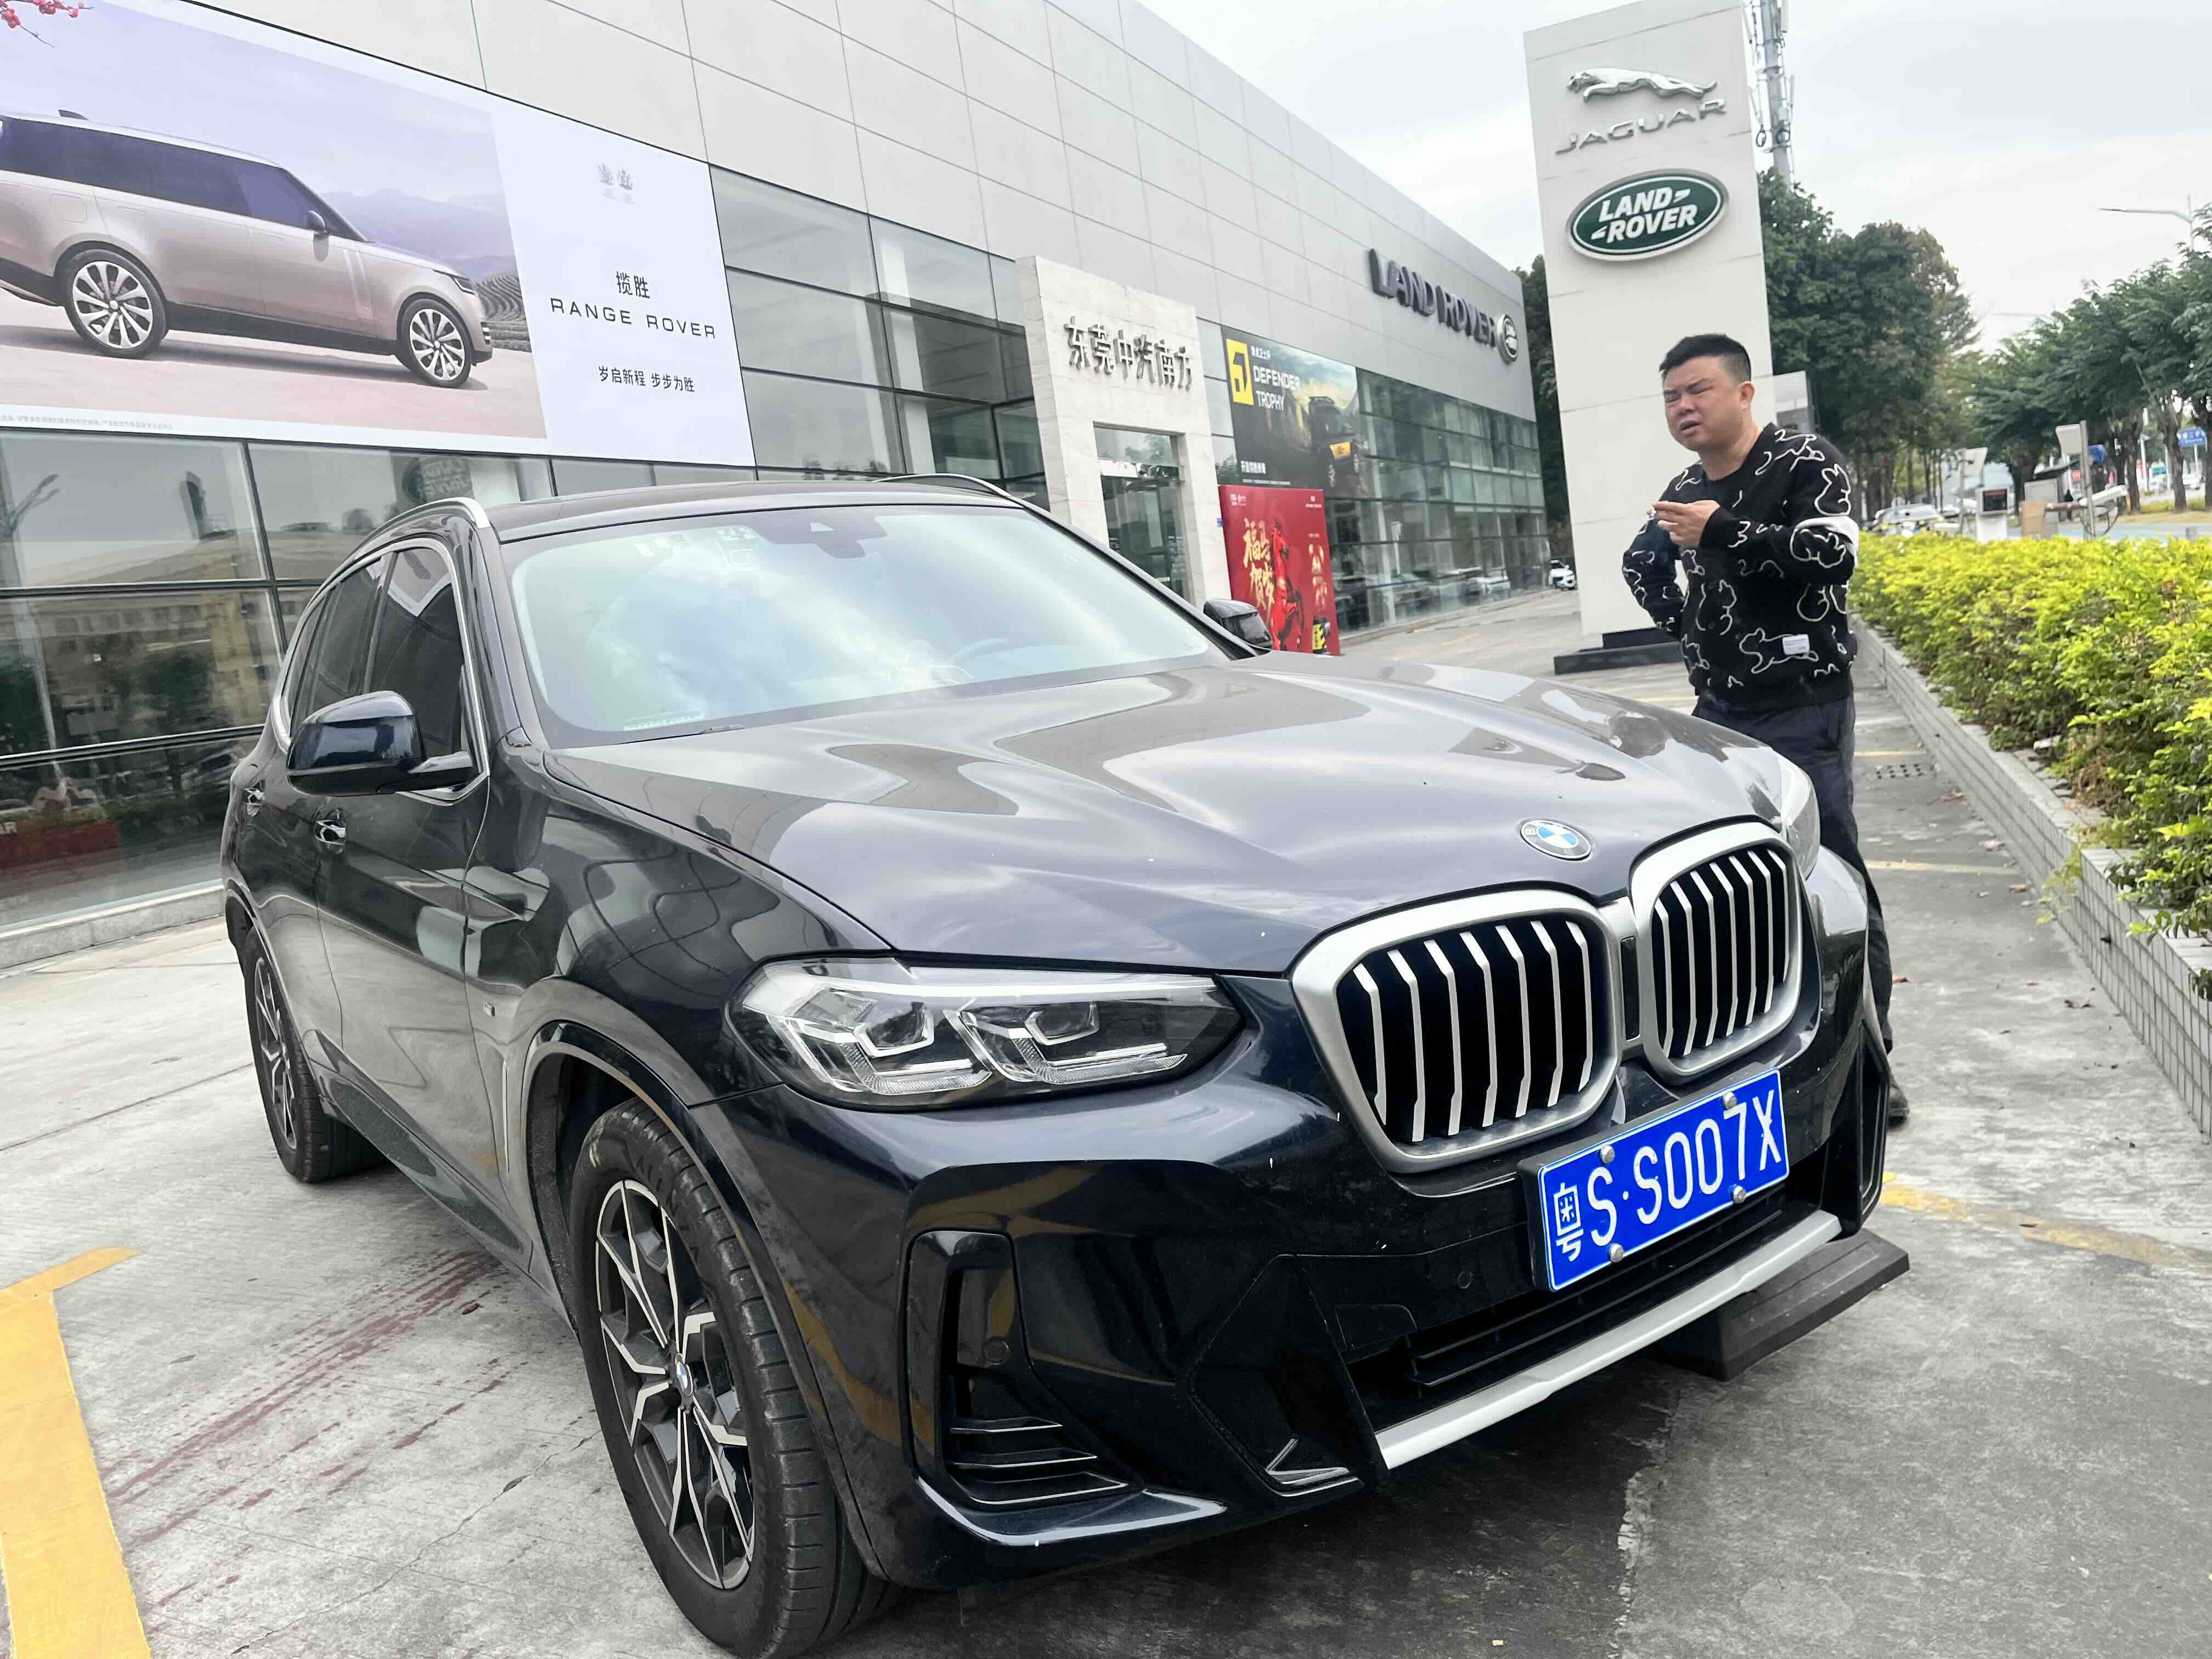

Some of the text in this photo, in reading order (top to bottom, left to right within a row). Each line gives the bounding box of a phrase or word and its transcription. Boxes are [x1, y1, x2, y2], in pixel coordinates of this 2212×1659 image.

[1556, 99, 1726, 155] JAGUAR
[1599, 187, 1673, 223] LAND
[1606, 204, 1698, 244] ROVER
[616, 270, 651, 300] 揽胜
[1368, 248, 1435, 317] LAND
[550, 297, 716, 339] RANGE ROVER
[1064, 315, 1192, 391] 东莞中汽南方
[598, 365, 695, 393] 岁启新程 步步为胜
[1253, 365, 1301, 390] DEFENDER
[1255, 390, 1285, 411] TROPHY
